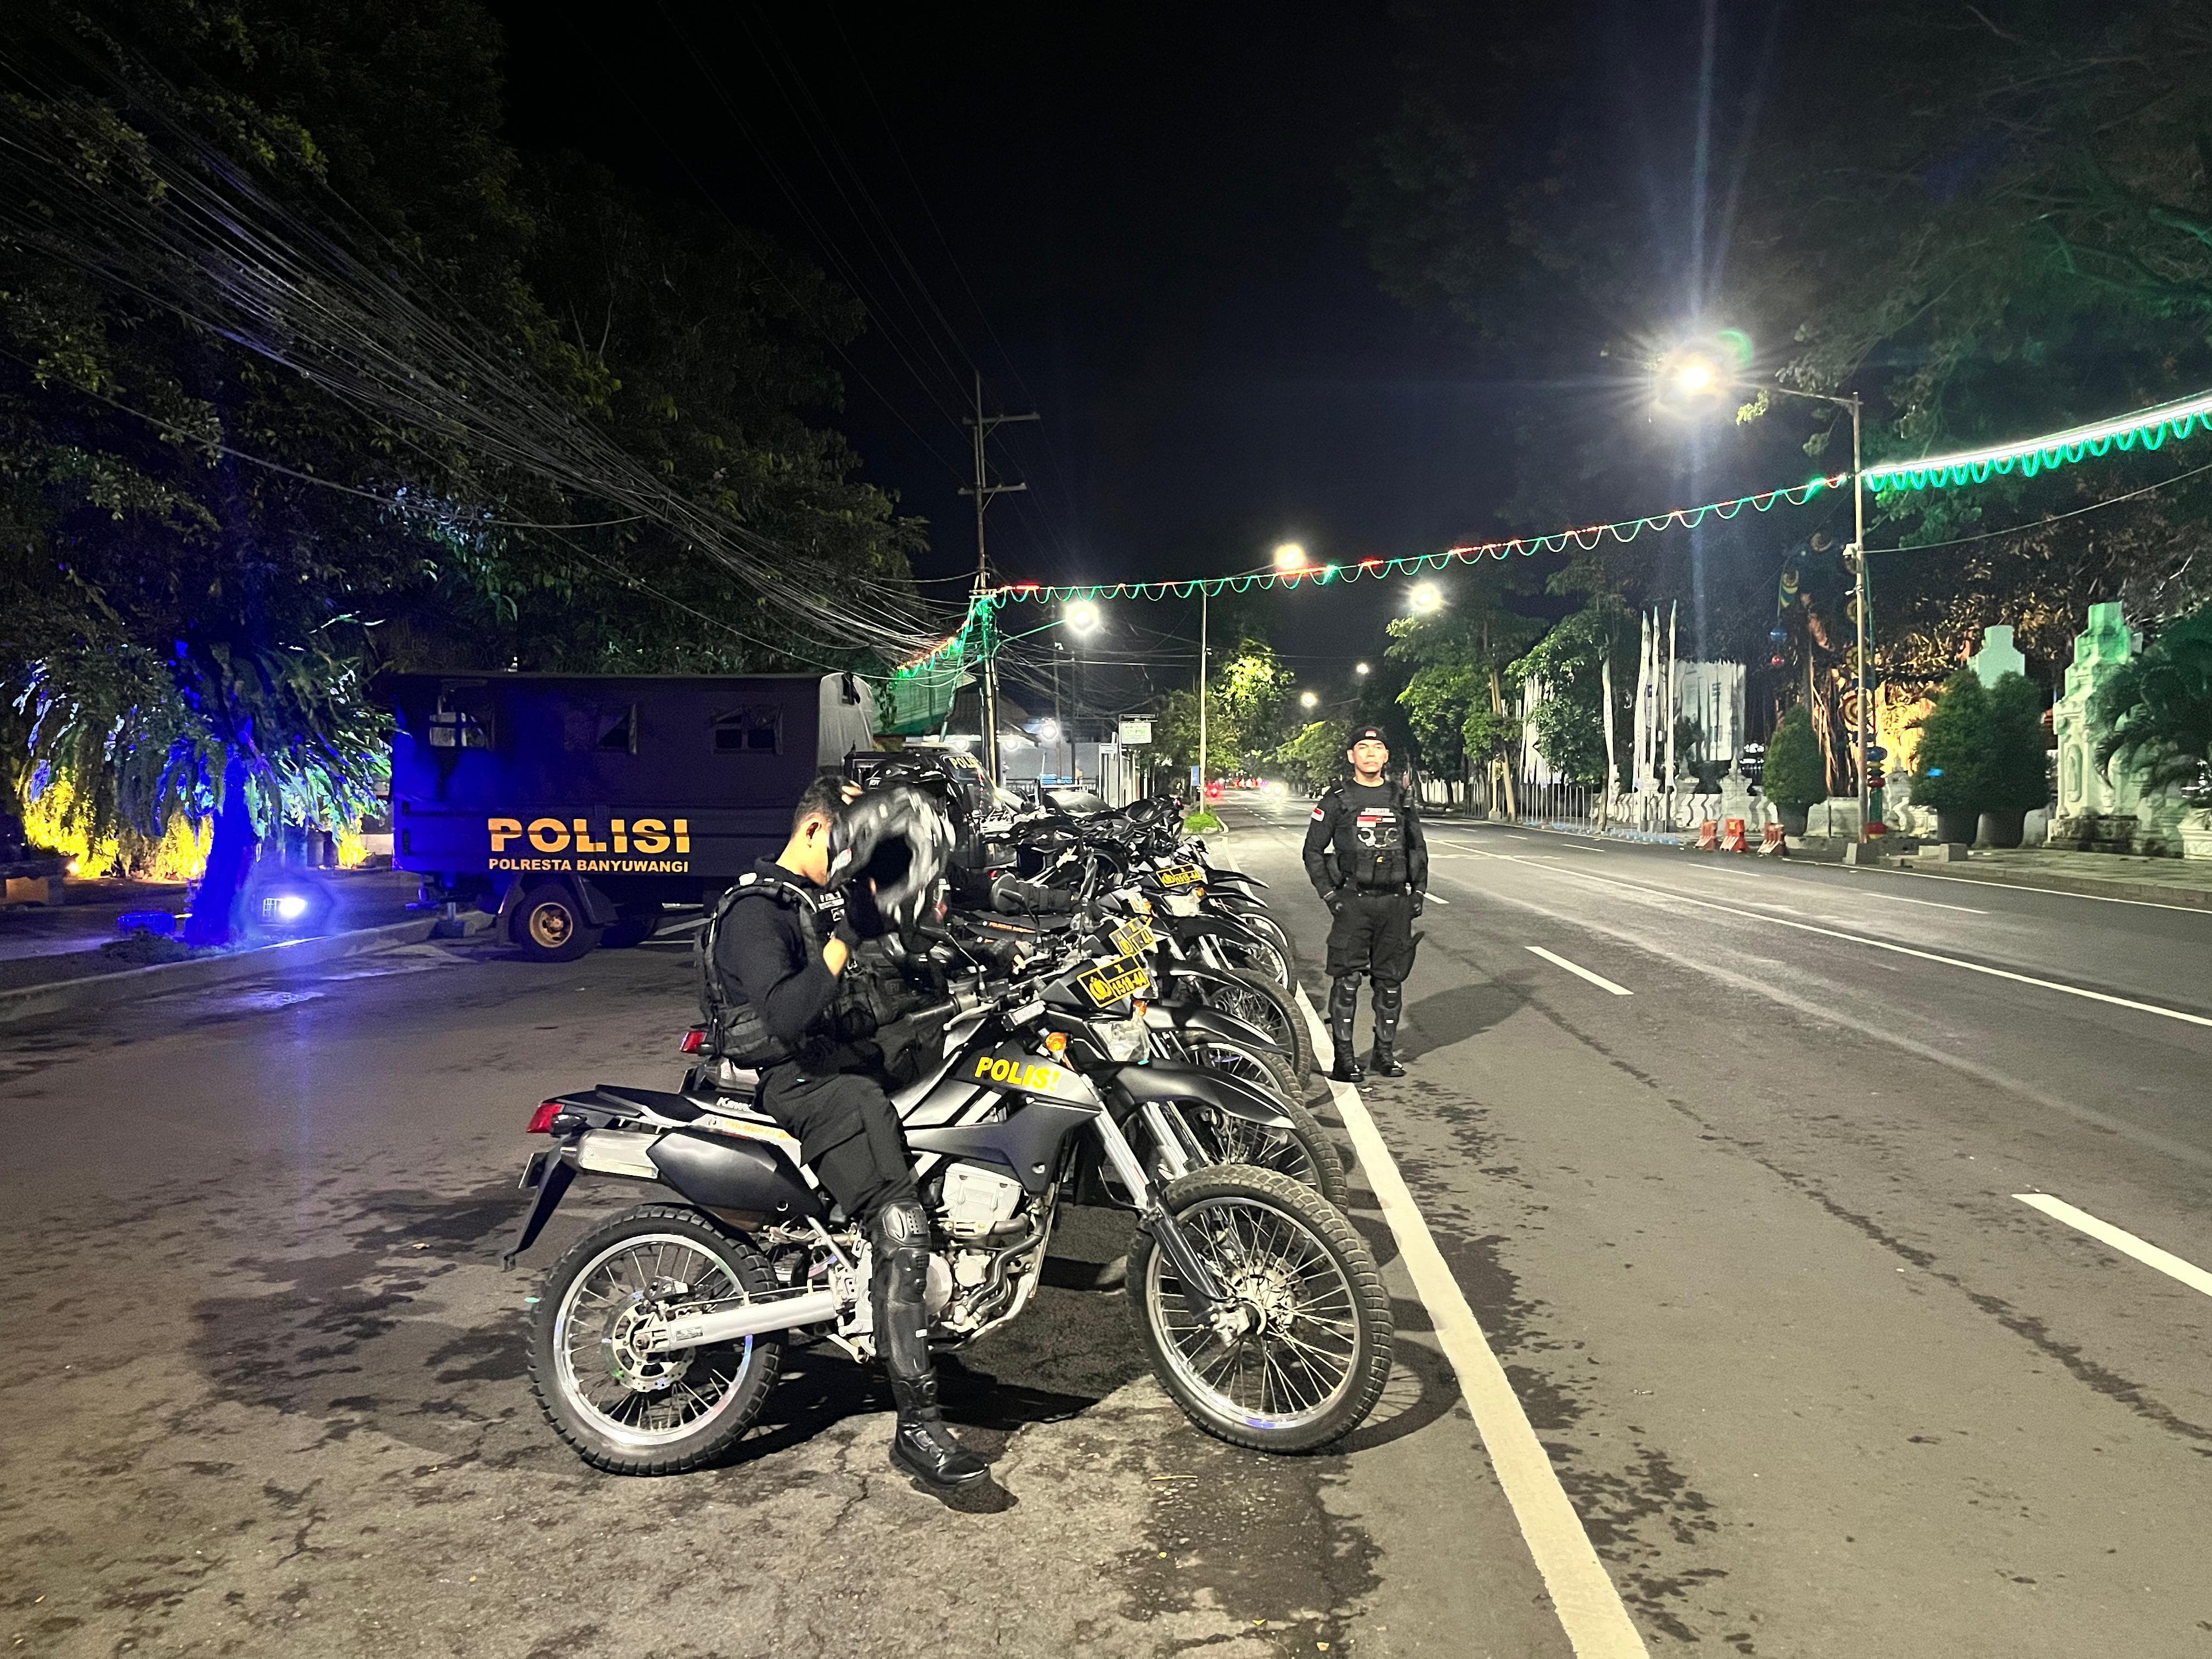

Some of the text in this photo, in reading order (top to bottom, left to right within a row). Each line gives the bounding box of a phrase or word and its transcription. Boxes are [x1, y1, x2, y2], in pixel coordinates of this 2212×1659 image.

[488, 818, 690, 854] POLISI
[489, 859, 689, 872] POLRESTA BANYUWANGI
[974, 1056, 1061, 1091] POLISI
